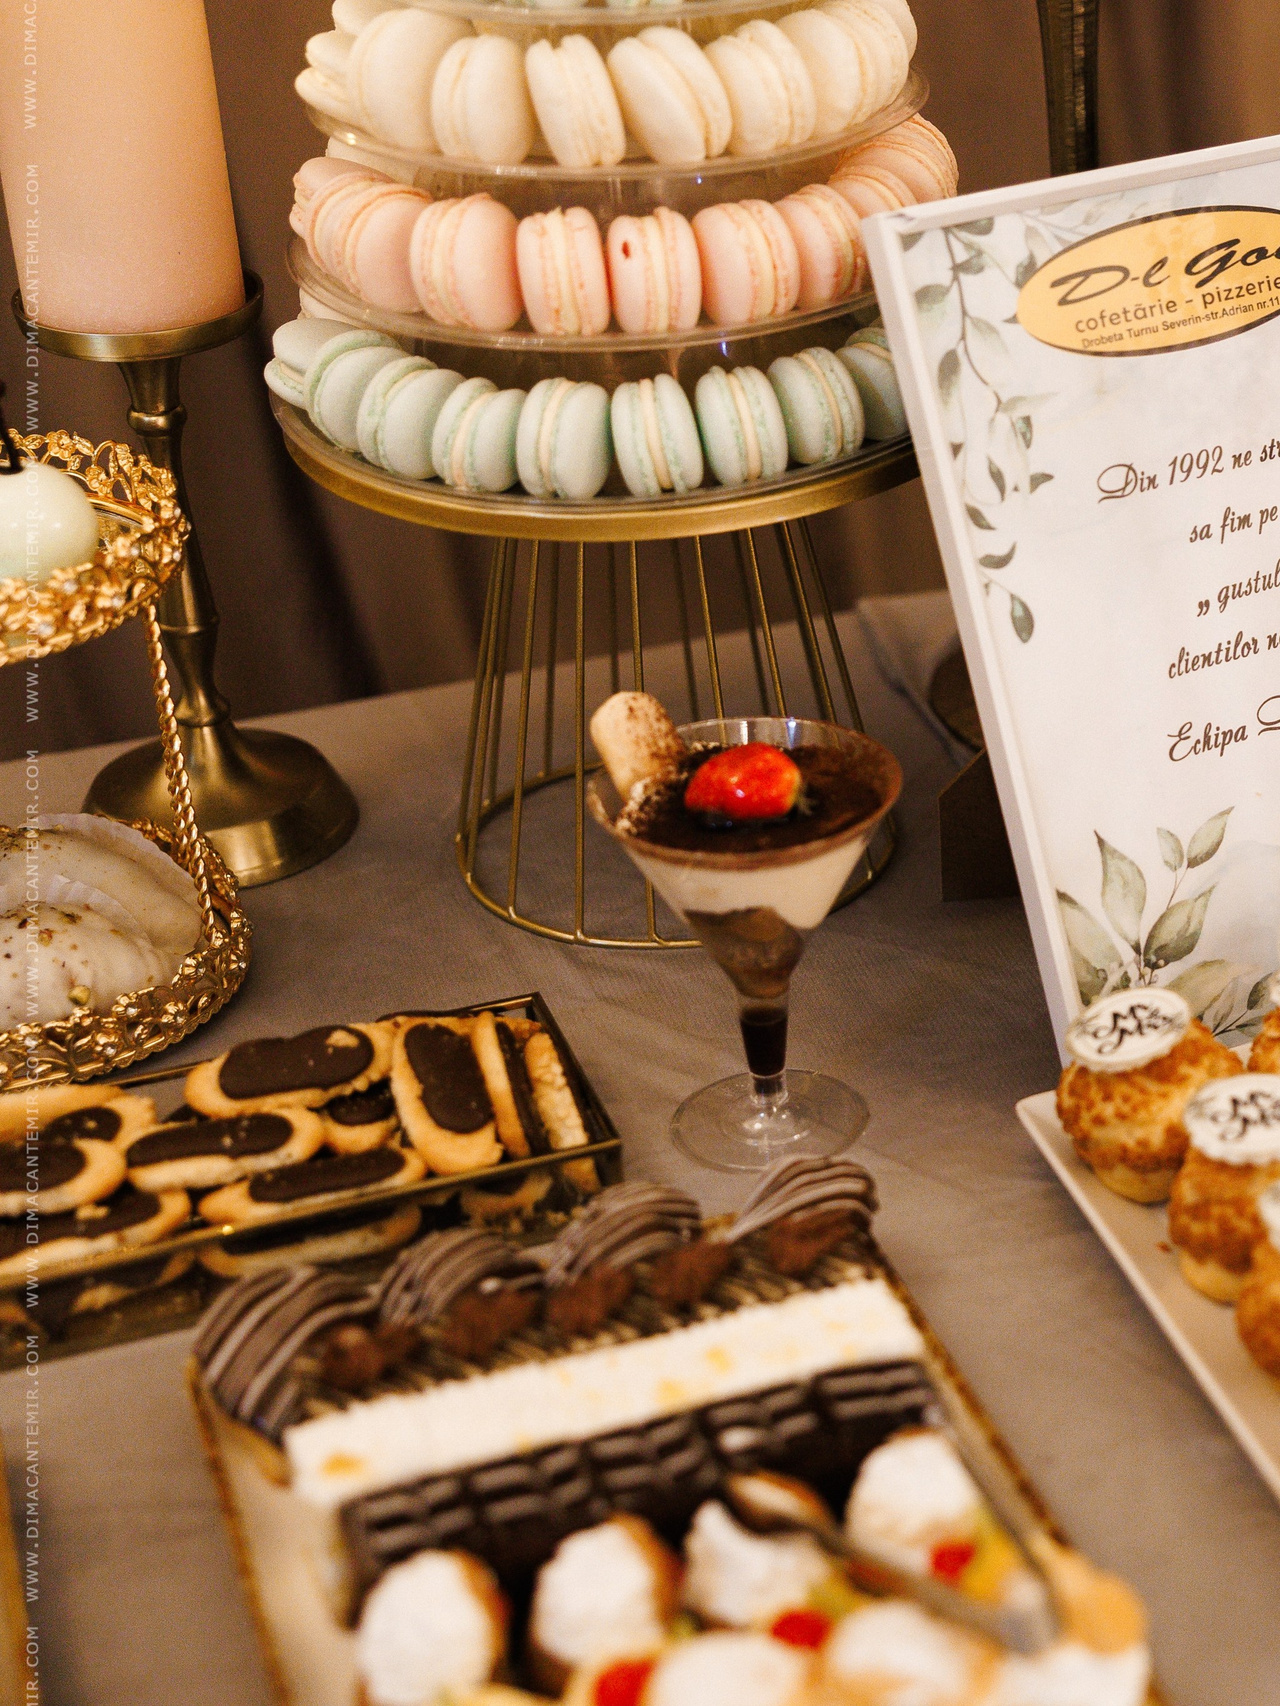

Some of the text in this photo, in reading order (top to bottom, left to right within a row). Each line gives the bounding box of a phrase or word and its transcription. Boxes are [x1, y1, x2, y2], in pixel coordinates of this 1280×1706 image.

[1081, 331, 1124, 349] Drobeta
[1127, 324, 1159, 338] Turnu
[1097, 462, 1158, 504] Din
[1167, 445, 1225, 486] 1992
[1231, 449, 1252, 470] ne
[1189, 505, 1279, 544] sa fim pe
[1168, 630, 1260, 679] clientilor
[1167, 721, 1248, 762] Echipa
